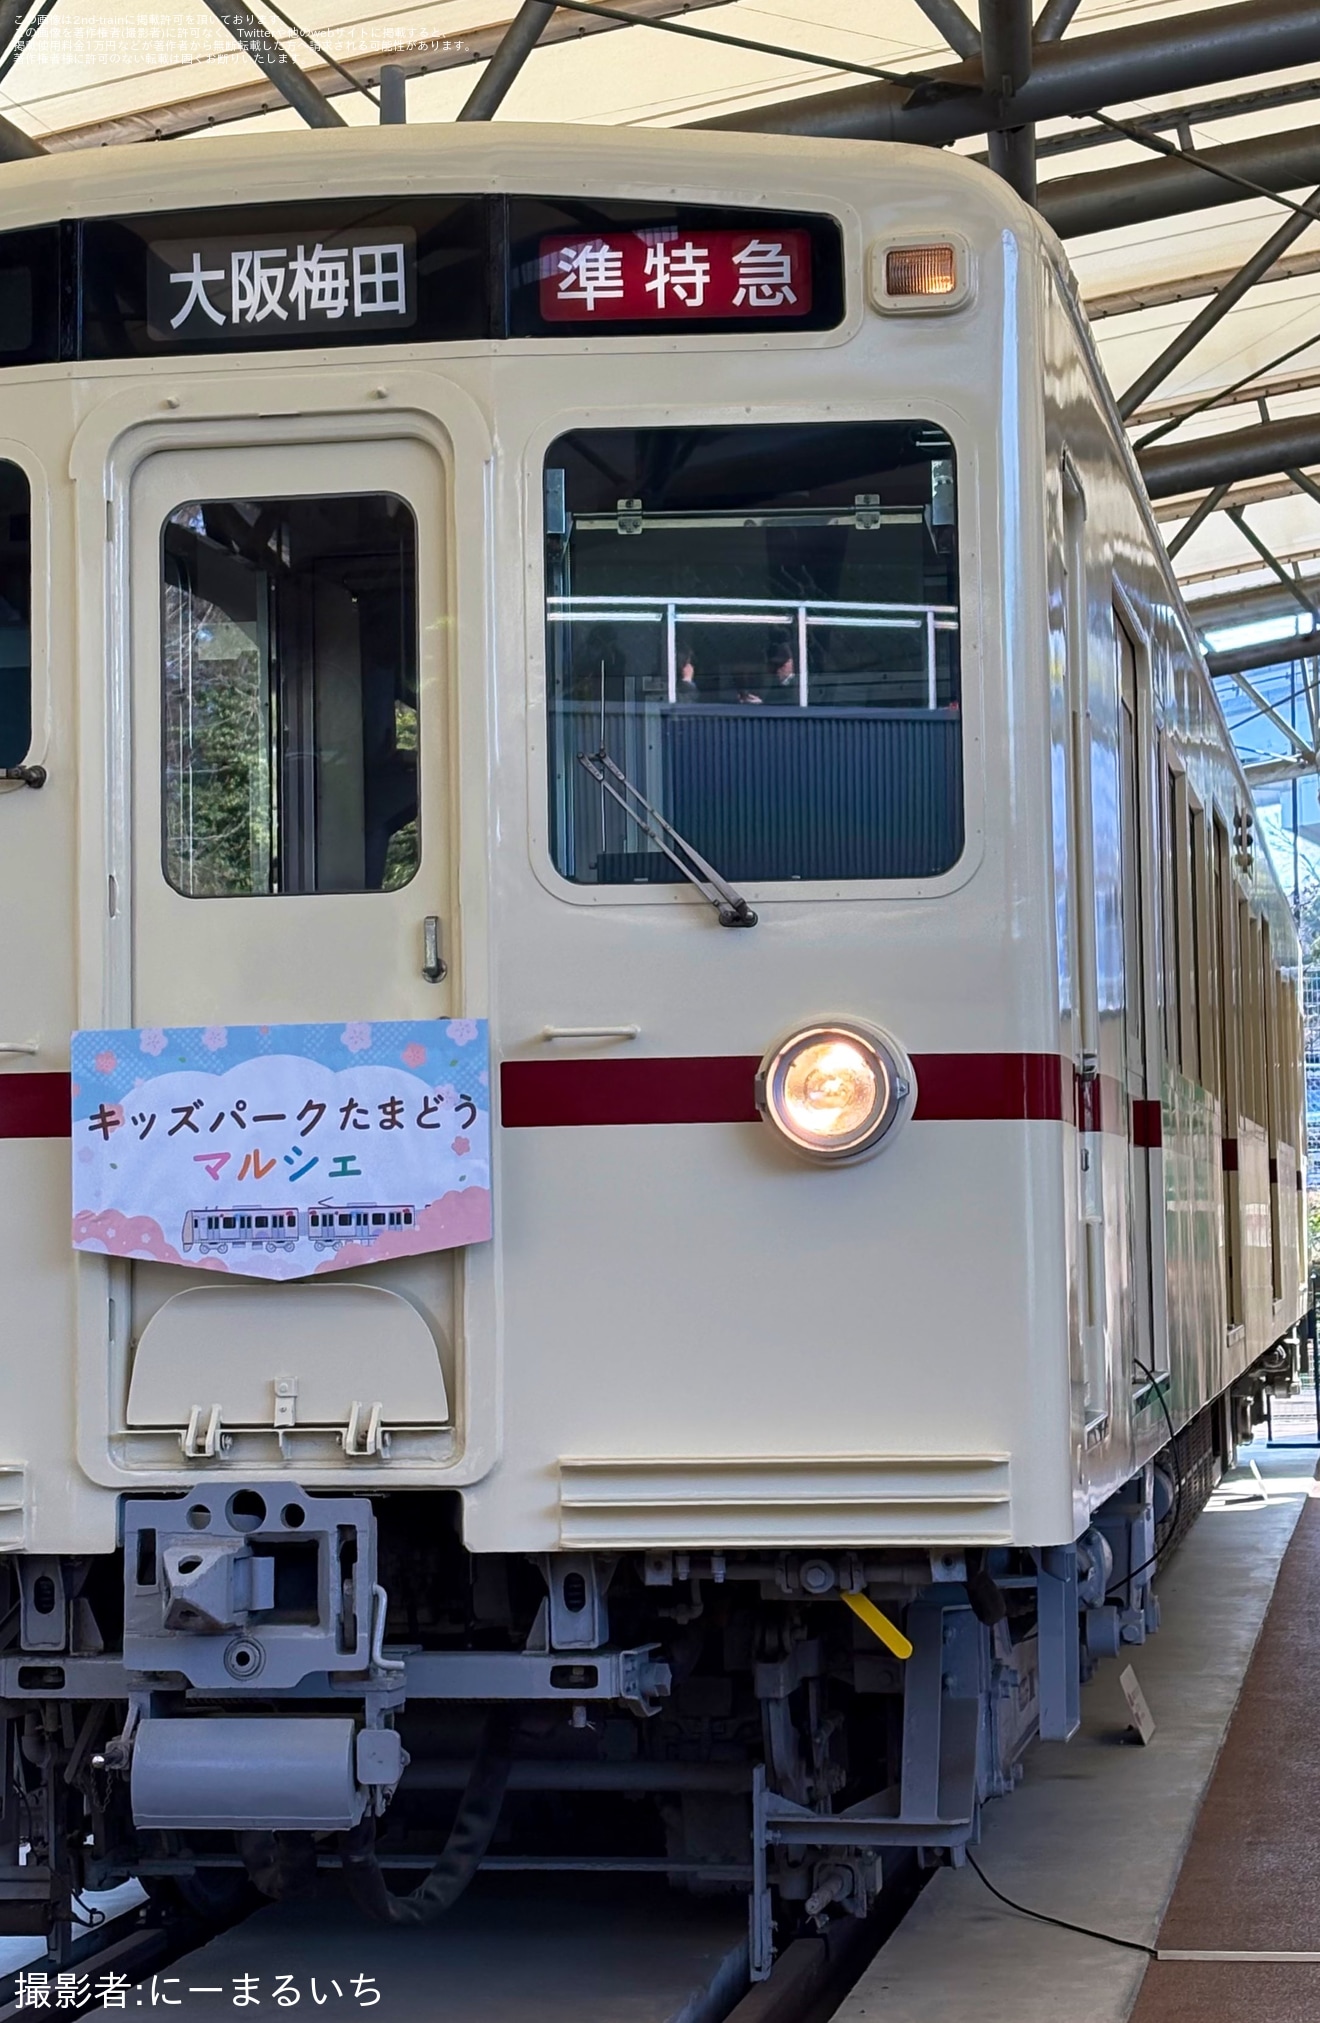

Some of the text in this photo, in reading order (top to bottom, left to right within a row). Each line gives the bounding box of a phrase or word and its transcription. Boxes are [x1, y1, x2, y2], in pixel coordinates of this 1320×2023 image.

[169, 243, 406, 330] 大阪梅田
[557, 239, 798, 311] 準特急
[88, 1093, 478, 1141] キッズパークたまどう
[193, 1145, 363, 1182] マルシェ
